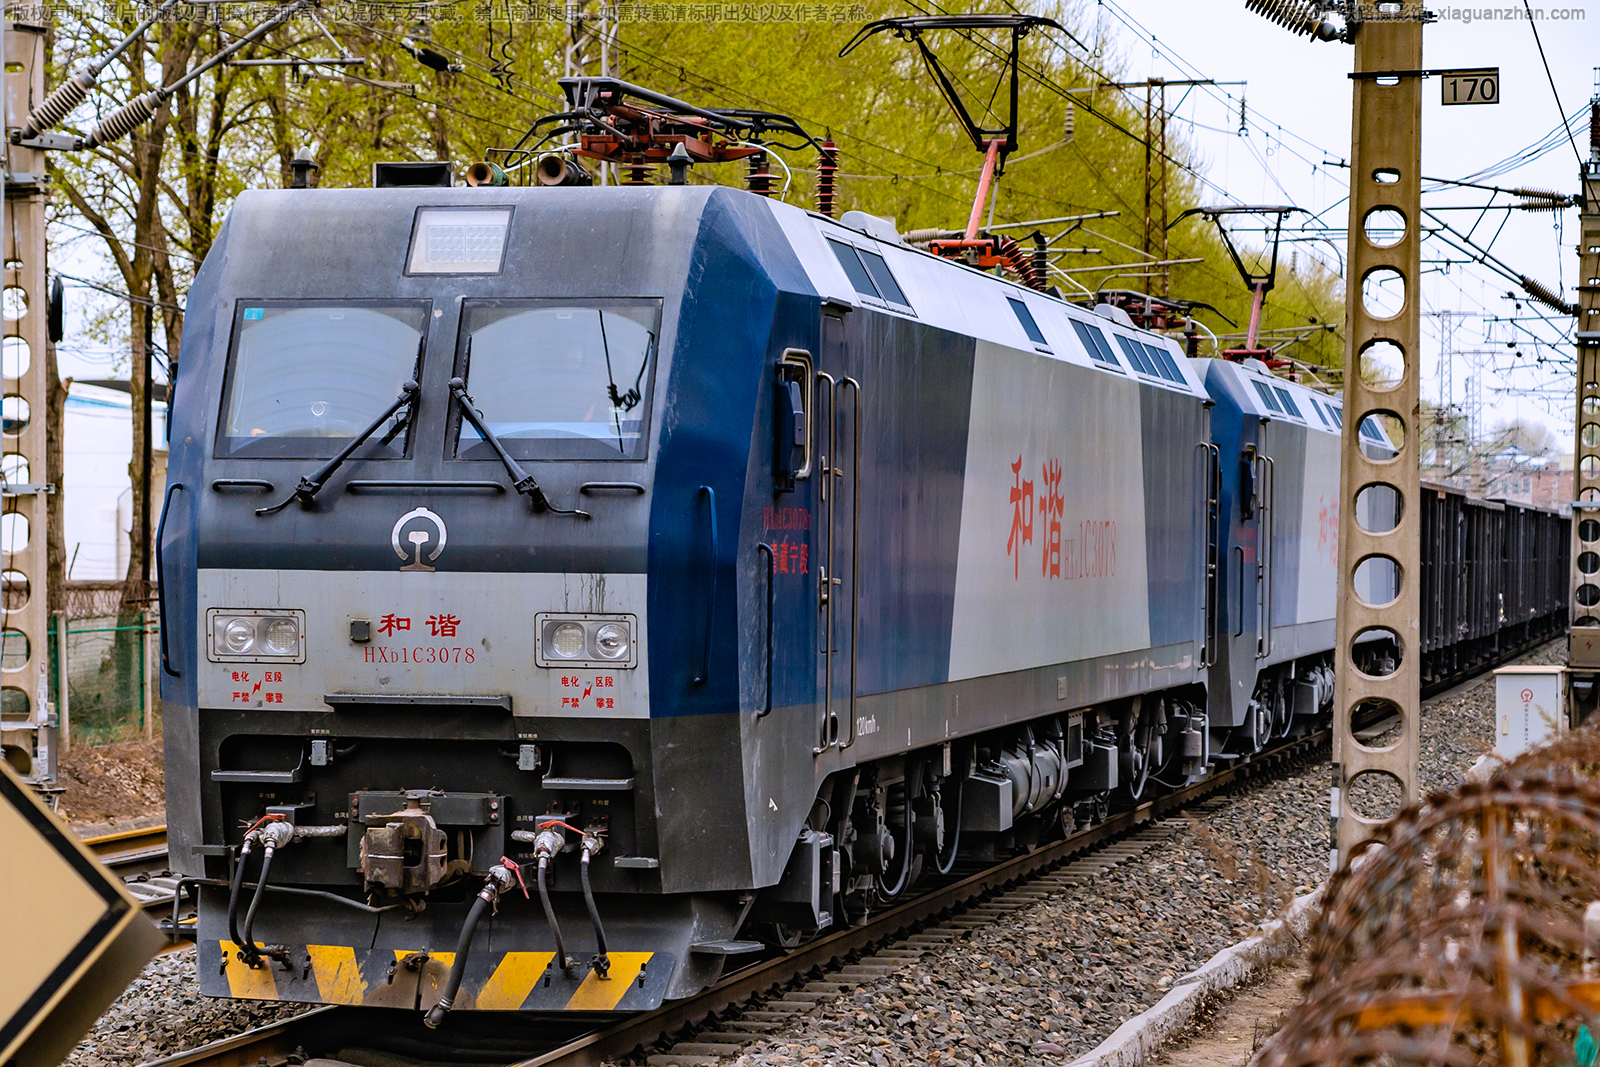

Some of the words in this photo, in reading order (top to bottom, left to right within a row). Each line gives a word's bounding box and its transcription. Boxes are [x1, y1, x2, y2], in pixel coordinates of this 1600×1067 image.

[1449, 77, 1496, 102] 170
[1006, 453, 1065, 581] 和谐
[377, 613, 461, 638] 和谐
[231, 671, 250, 683] 电化
[264, 671, 283, 683] 区段
[561, 676, 580, 688] 电化
[595, 676, 614, 688] 区段
[232, 692, 250, 704] 严禁
[561, 697, 580, 709] 严禁
